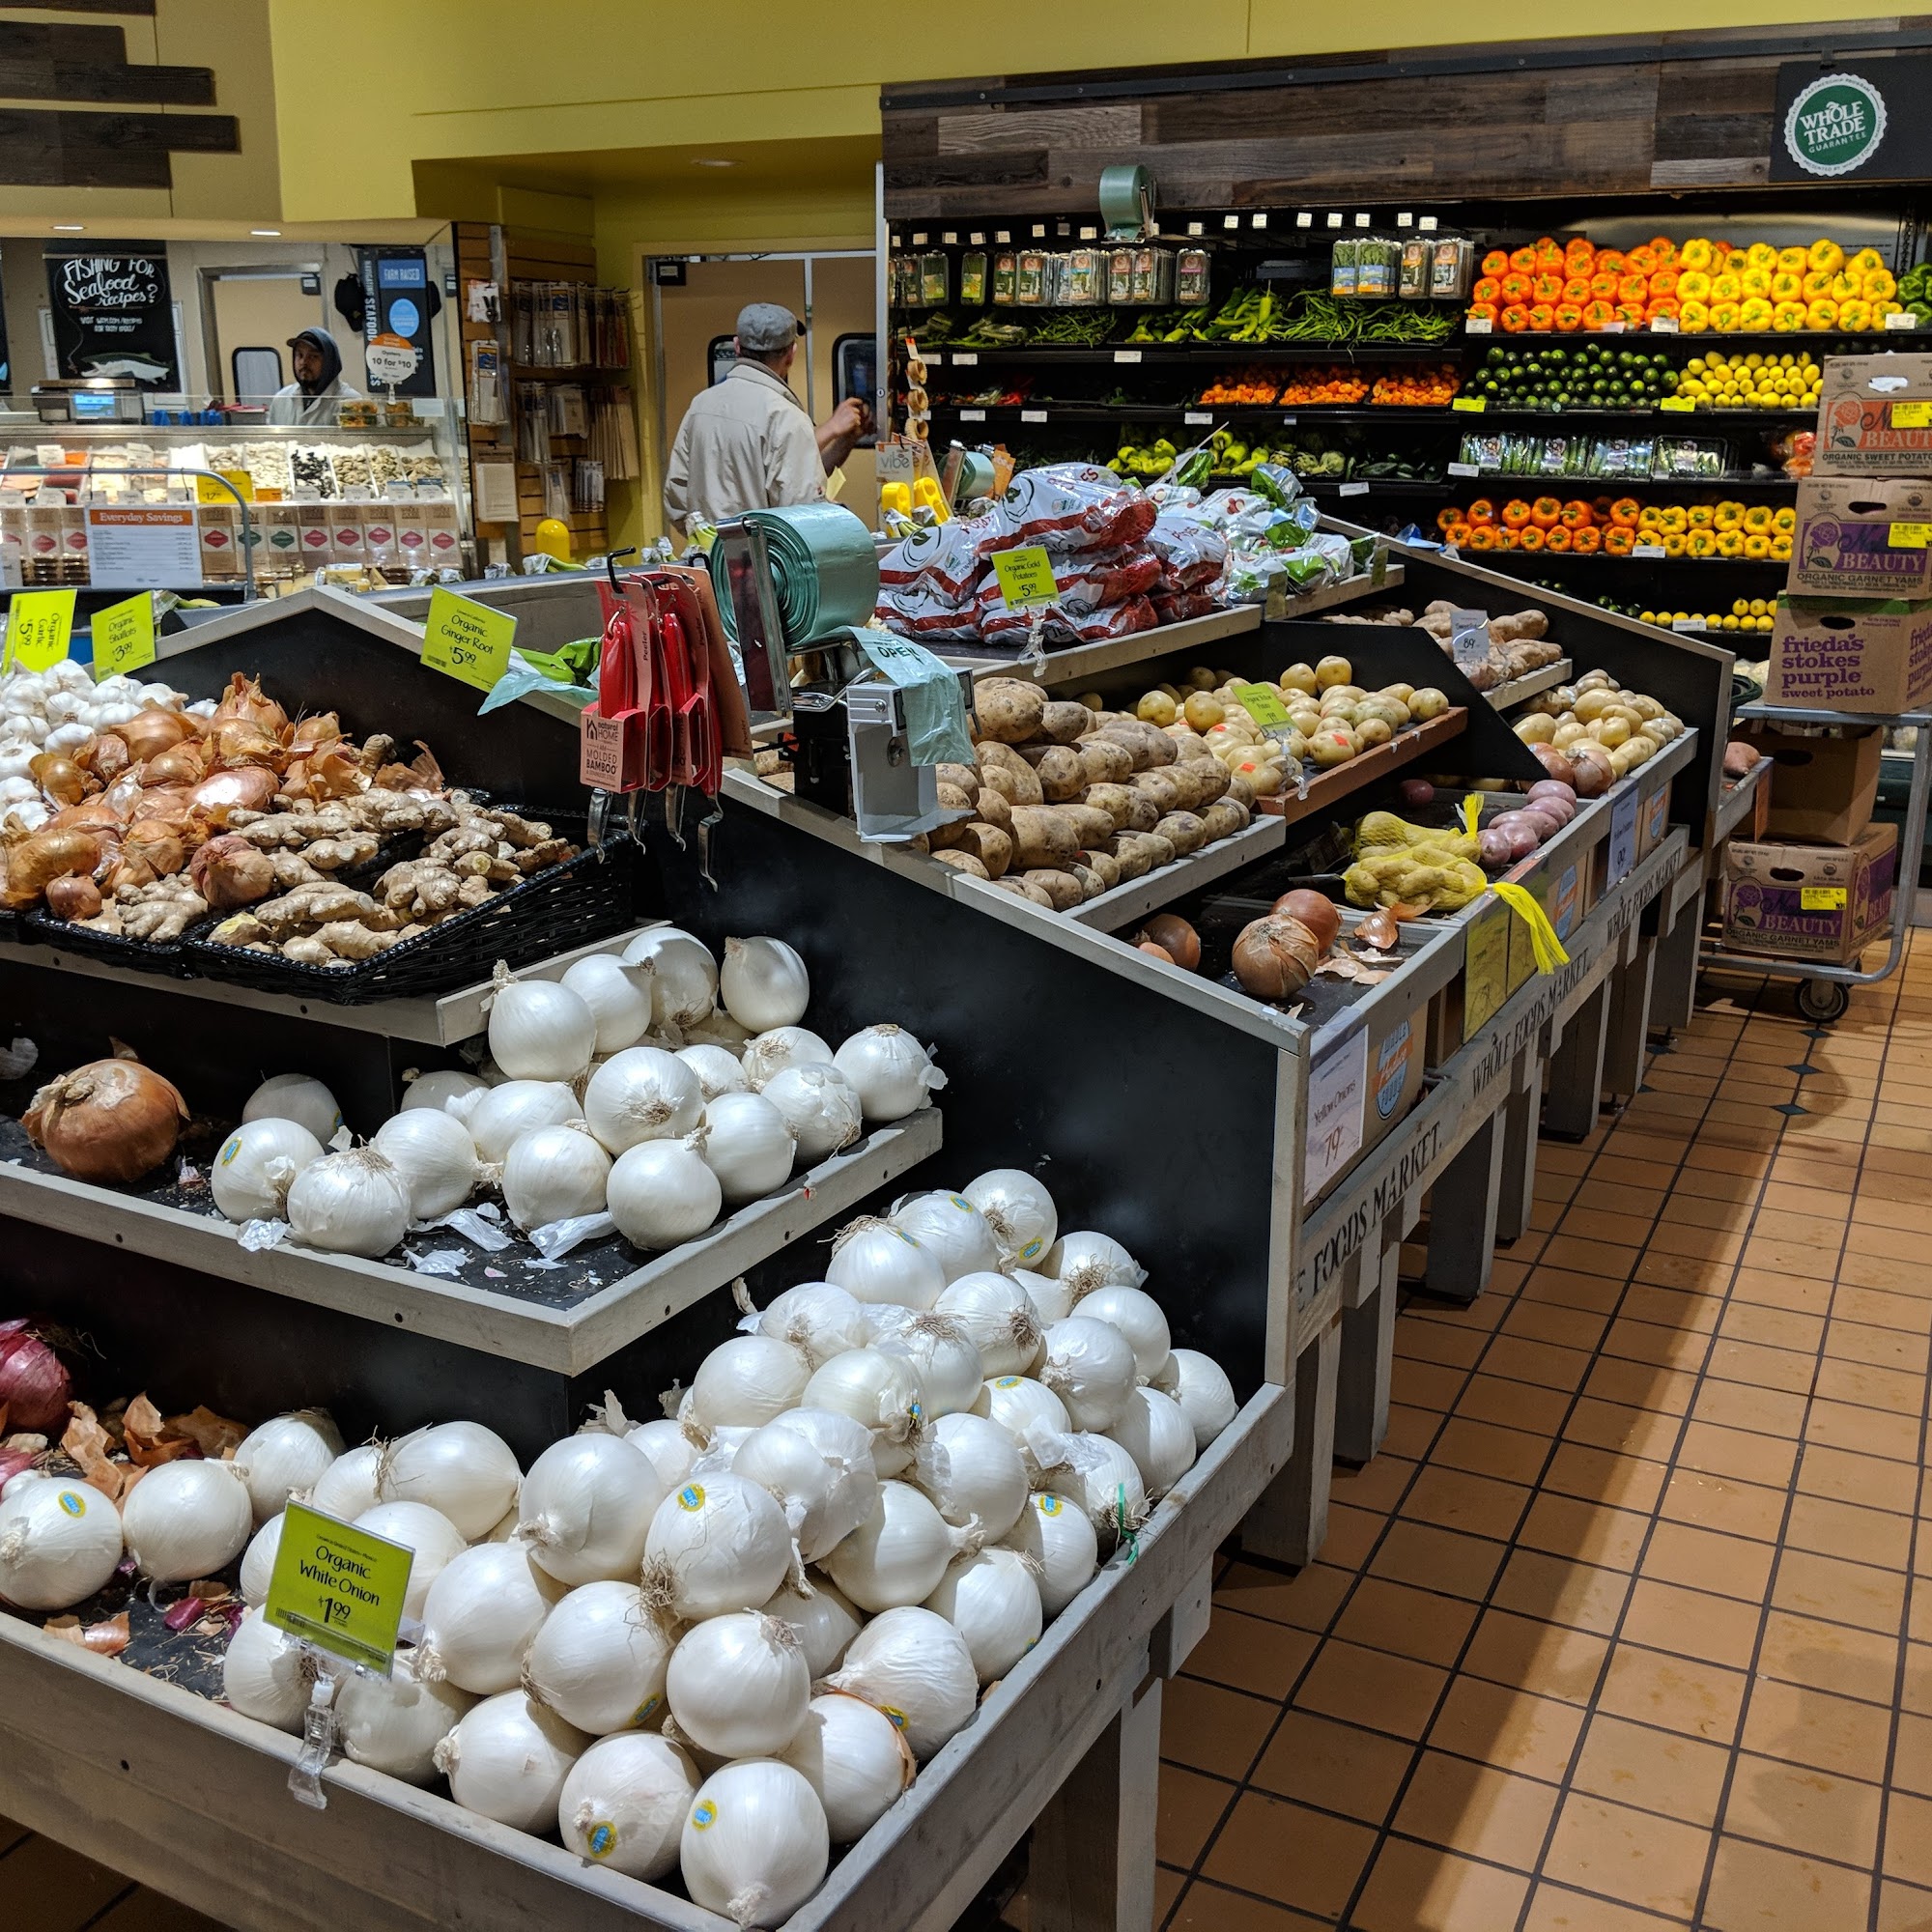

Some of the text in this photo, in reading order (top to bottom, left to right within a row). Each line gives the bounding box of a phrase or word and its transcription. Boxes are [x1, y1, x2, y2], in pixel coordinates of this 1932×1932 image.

[1799, 100, 1864, 130] WHOLE
[1804, 116, 1866, 146] TRADE
[1808, 131, 1866, 154] GUARANTEE
[64, 258, 155, 281] FISHING FOR
[64, 271, 140, 304] Seafood
[880, 451, 910, 469] vibe
[99, 512, 184, 524] Everyday Savings
[1005, 560, 1041, 573] Organic Gold
[1841, 552, 1922, 572] BEAUTY
[1012, 571, 1038, 581] Potatoes
[1797, 573, 1923, 585] ORGANIC GARNET YAMS
[36, 618, 47, 648] Garlic
[46, 612, 60, 652] Organic
[108, 616, 135, 633] Organic
[451, 614, 489, 638] Organic
[108, 628, 137, 644] Shallots
[440, 624, 495, 655] Ginger Root
[1782, 634, 1864, 653] frieda's
[1781, 653, 1861, 668] stokes
[1781, 668, 1861, 689] purple
[1781, 686, 1875, 699] sweet potato
[597, 729, 618, 742] HOME
[598, 722, 618, 731] natural
[586, 748, 617, 764] MOLDED
[586, 759, 617, 775] BAMBOO
[1764, 915, 1841, 936] BEAUTY
[1725, 927, 1767, 941] ORGANIC
[1770, 933, 1810, 945] GARNET
[1812, 938, 1840, 948] YAMS
[1473, 1031, 1511, 1097] WHOLE
[1314, 1081, 1356, 1127] Yellow Onions
[316, 1546, 372, 1579] Organic
[299, 1559, 380, 1605] White Onion
